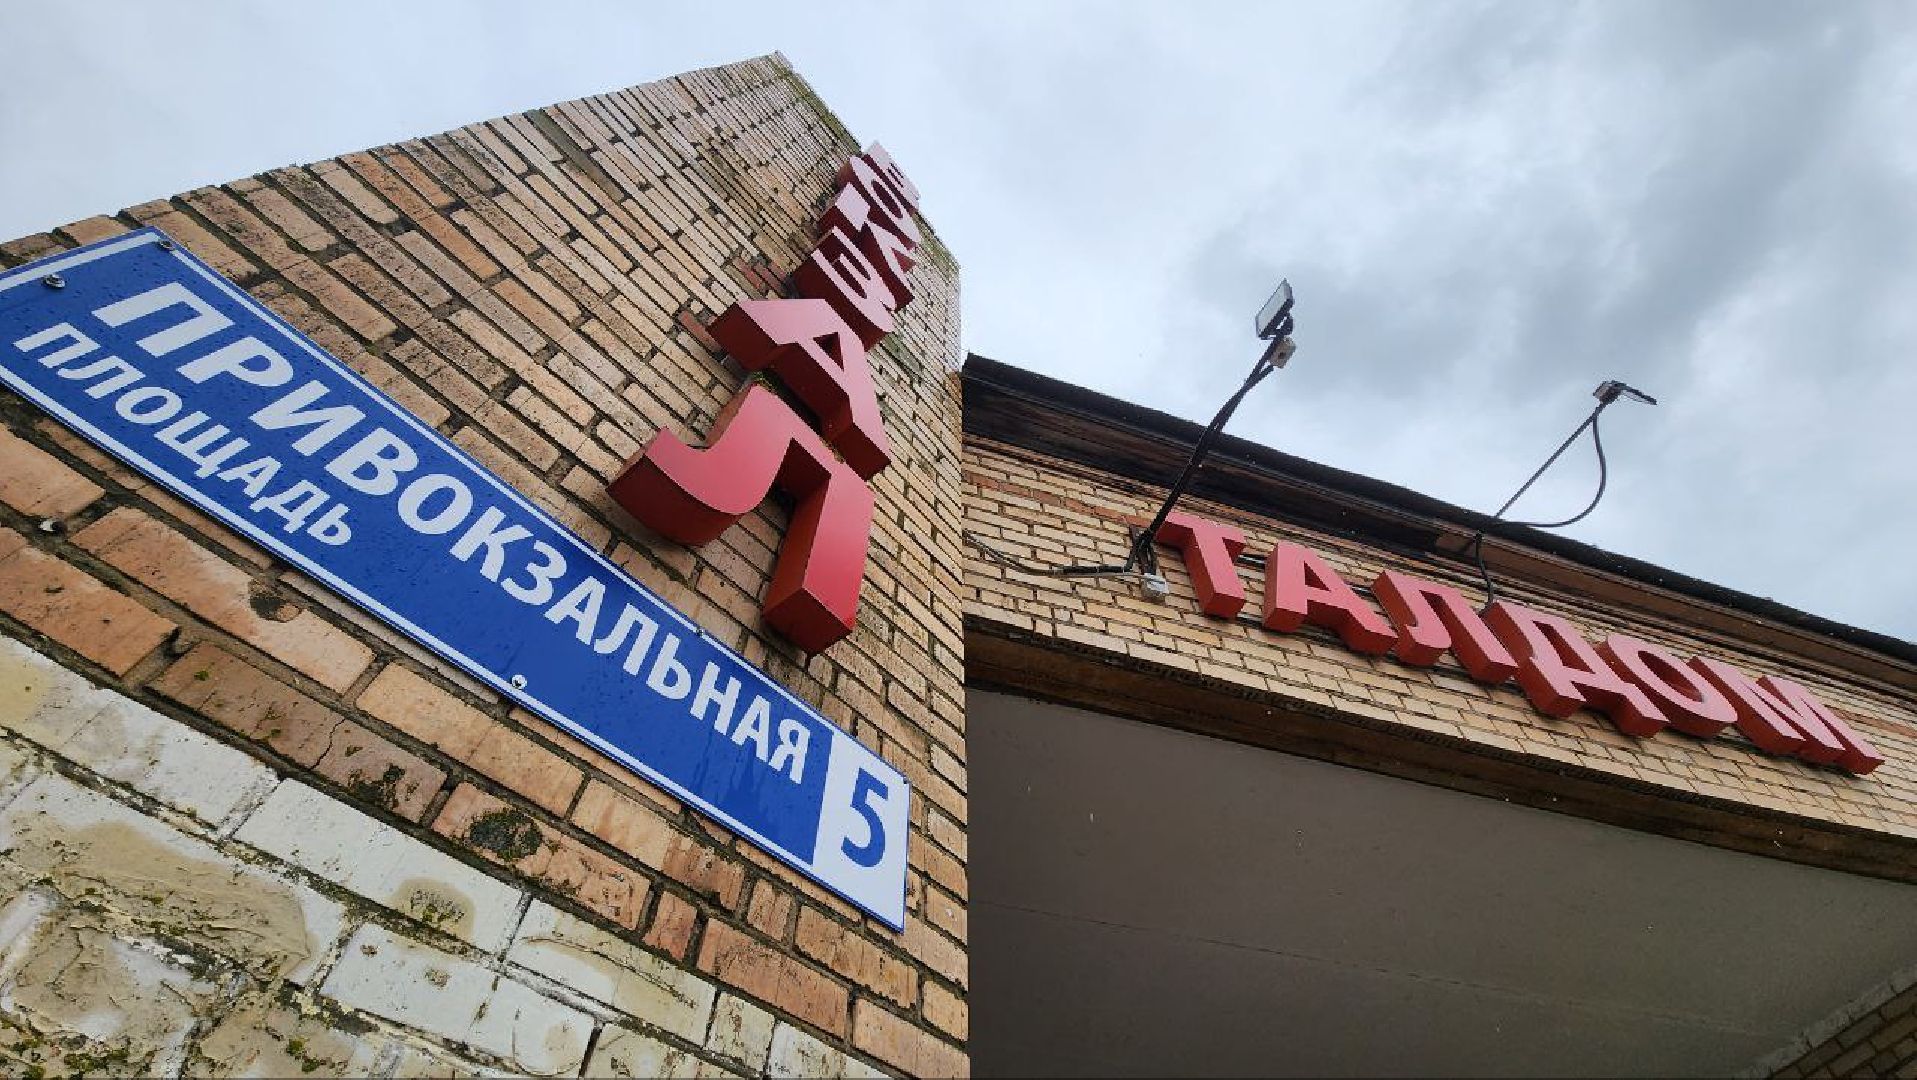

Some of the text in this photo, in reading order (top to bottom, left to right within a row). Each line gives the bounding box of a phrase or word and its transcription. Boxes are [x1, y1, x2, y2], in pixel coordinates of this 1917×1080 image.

[13, 322, 352, 546] ПЛОЩАДЬ
[608, 141, 920, 658] ВОКЗАЛ
[92, 282, 810, 784] ПРИВОКЗАЛЬНАЯ
[1157, 511, 1885, 775] ТАЛДОМ
[841, 766, 889, 868] 5
